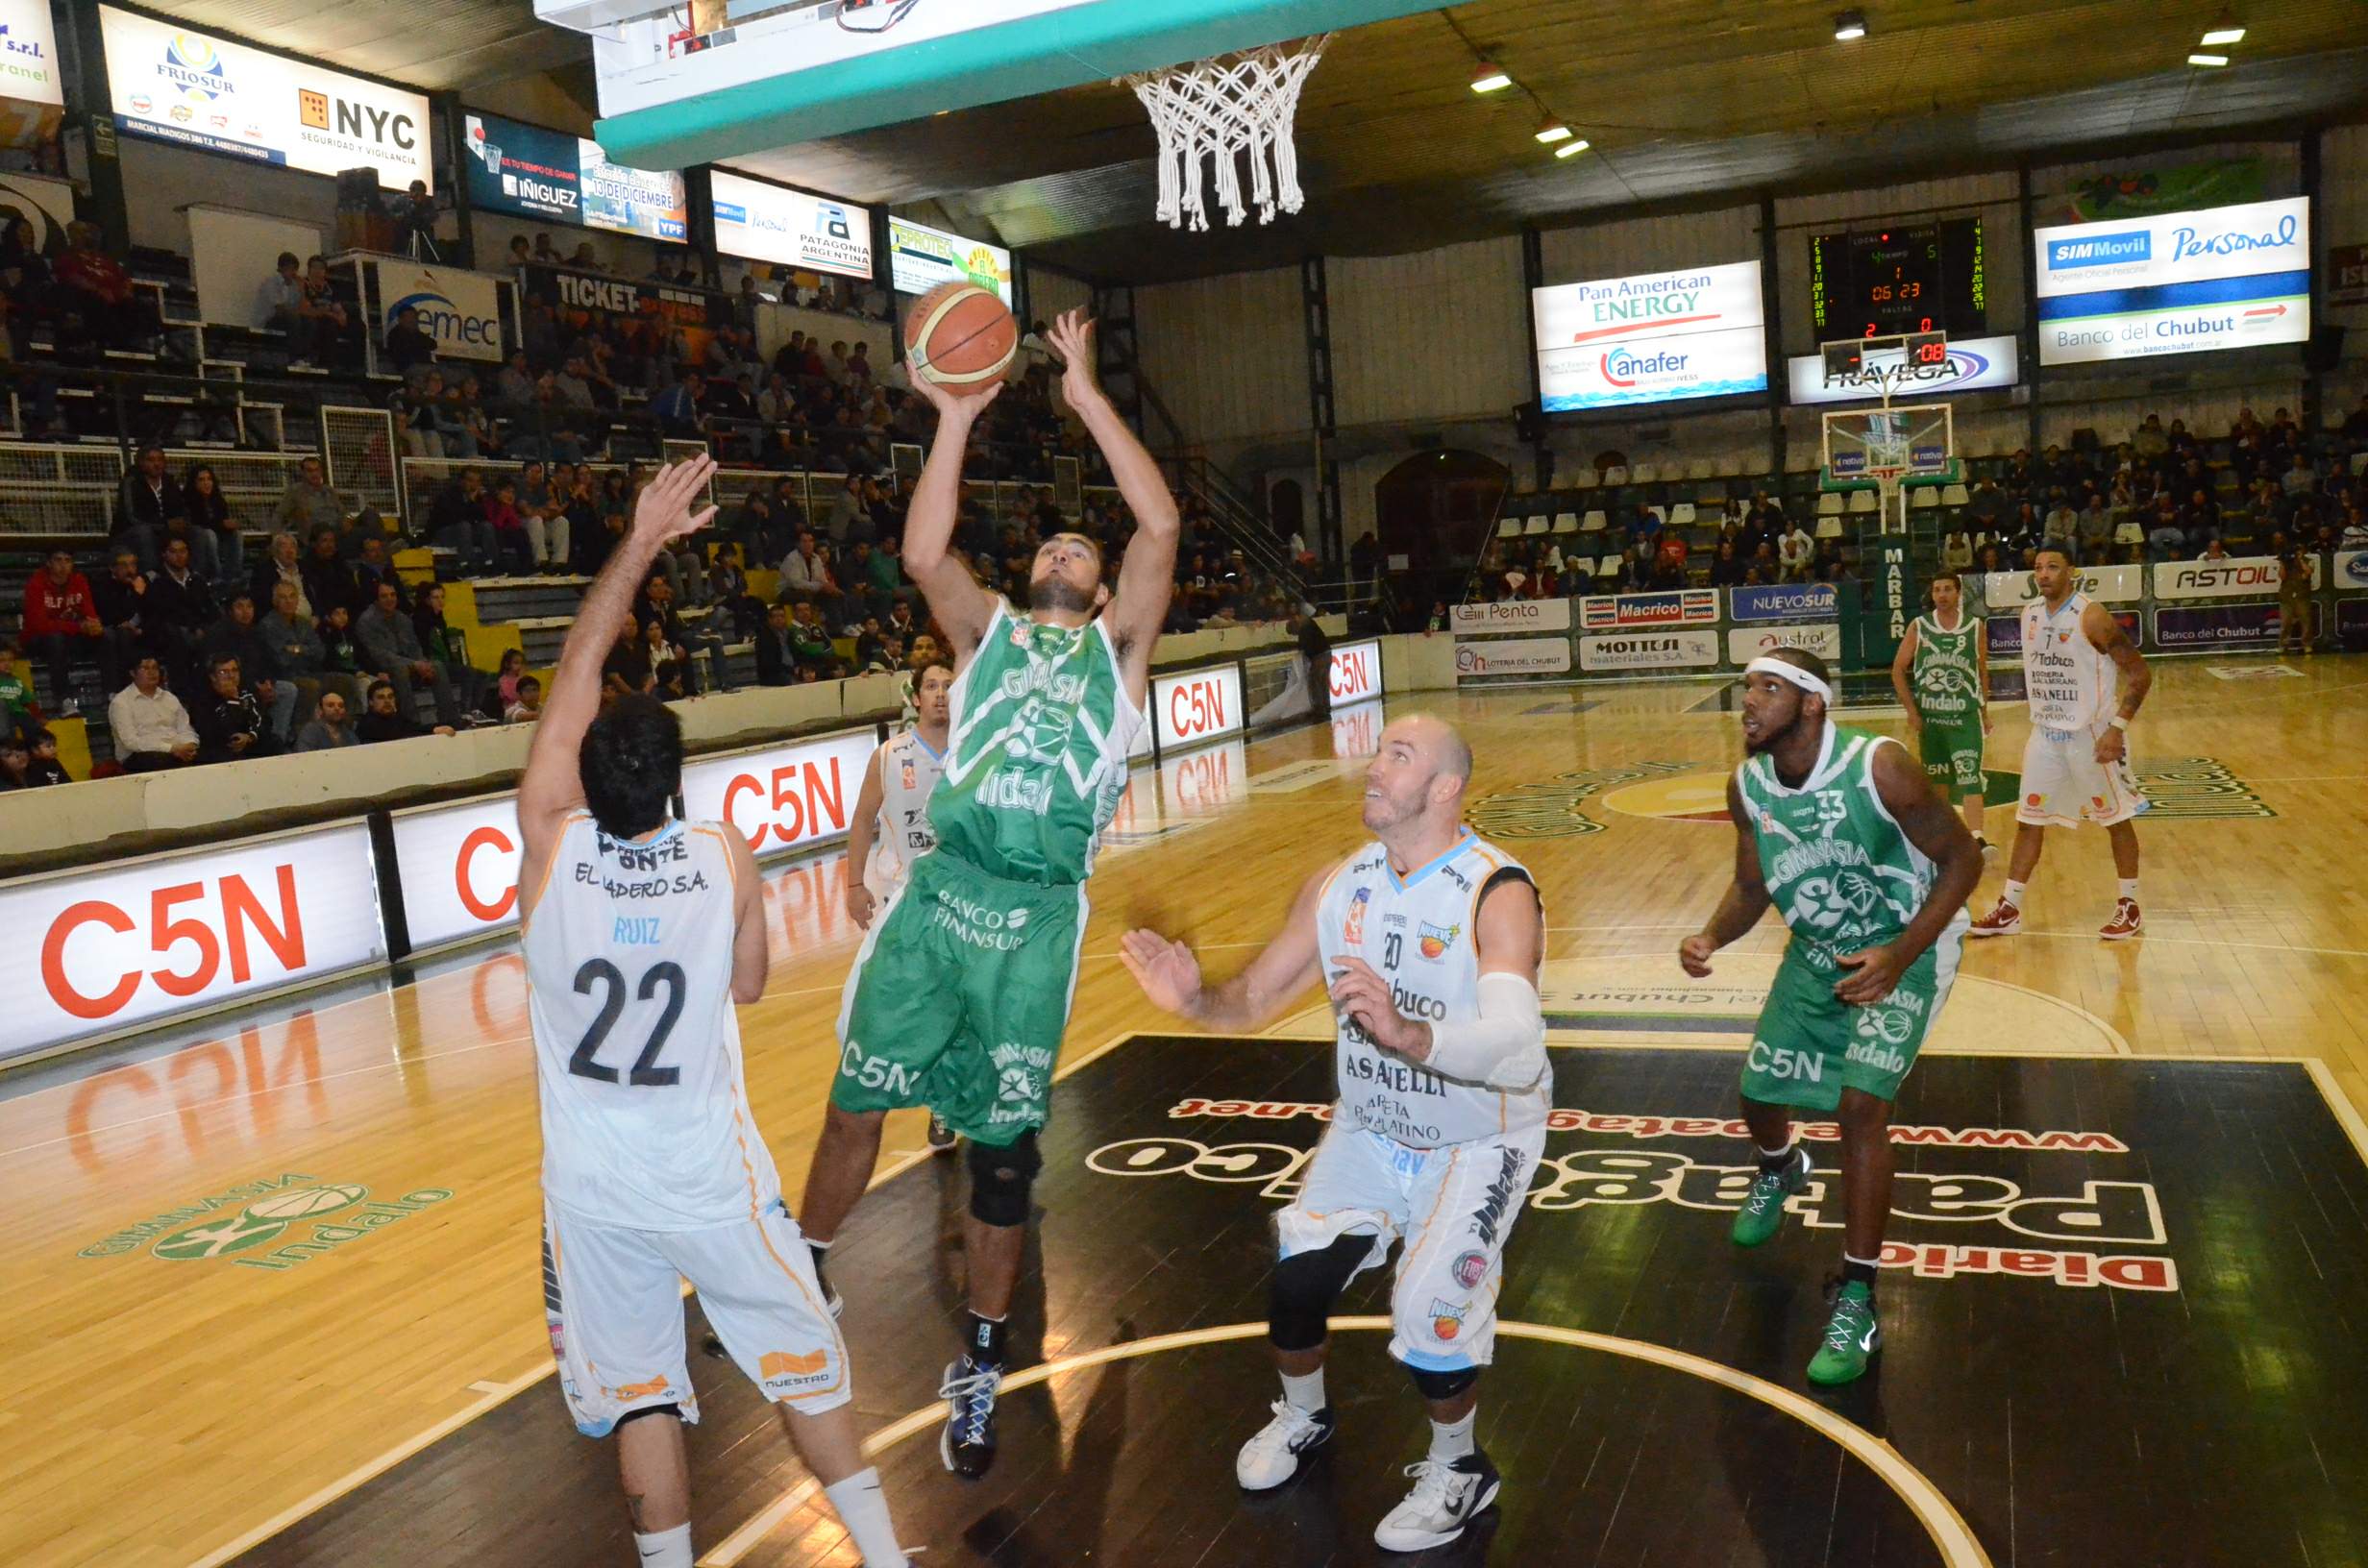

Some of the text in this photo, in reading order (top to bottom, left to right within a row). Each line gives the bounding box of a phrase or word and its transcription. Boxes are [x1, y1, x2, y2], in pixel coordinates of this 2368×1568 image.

[7, 40, 44, 59] s.r.l.
[157, 63, 234, 93] FRIOSUR
[336, 98, 415, 150] NYC
[301, 132, 355, 151] SEGURIDAD
[365, 146, 416, 165] VIGILANCIA
[521, 161, 545, 173] TIEMPO
[519, 178, 578, 208] IÑIGUEZ
[593, 180, 673, 209] 13 DE DICIEMBRE
[661, 223, 683, 235] YPF
[2056, 215, 2297, 262] SIMMovil Personal
[800, 233, 870, 256] PATAGONIA
[802, 245, 869, 264] ARGENTINA
[1927, 244, 1936, 258] 5
[556, 275, 640, 313] TICKET
[1579, 275, 1712, 302] Pan American
[1872, 282, 1920, 301] 06 23
[1593, 291, 1700, 323] ENERGY
[1866, 324, 1876, 337] 2
[1921, 318, 1931, 332] 0
[2058, 316, 2233, 347] Banco del Chubut
[1922, 344, 1944, 361] 08
[2177, 566, 2277, 589] ASTOIL
[1753, 594, 1836, 610] NUEVOSUR
[1886, 549, 1906, 638] MARBAR
[1490, 603, 1539, 619] Penta
[1620, 602, 1679, 618] Macrico
[1686, 609, 1713, 618] Macrico
[1957, 635, 1967, 649] 8
[2162, 626, 2260, 641] Banco del Chubut
[1488, 659, 1516, 668] LOTERIA
[1532, 657, 1561, 666] CHUBUT
[1590, 652, 1686, 665] materiales S.A.
[1329, 651, 1369, 698] C5N
[1171, 679, 1225, 739] C5N
[1921, 694, 1966, 711] Indalo
[1923, 764, 1949, 775] 5N
[723, 756, 846, 852] C5N
[1814, 790, 1847, 820] 33
[575, 862, 600, 884] EL
[673, 870, 709, 894] S.A.
[41, 864, 308, 1019] C5N
[613, 917, 660, 944] RUIZ
[1384, 932, 1402, 971] 20
[1392, 983, 1446, 1021] buco
[569, 958, 686, 1086] 22
[841, 1041, 920, 1096] C5N
[1747, 1041, 1825, 1083] C5N
[77, 1172, 321, 1259] GIMNASIA
[231, 1188, 455, 1270] Indalo
[1879, 1240, 2179, 1291] Diario
